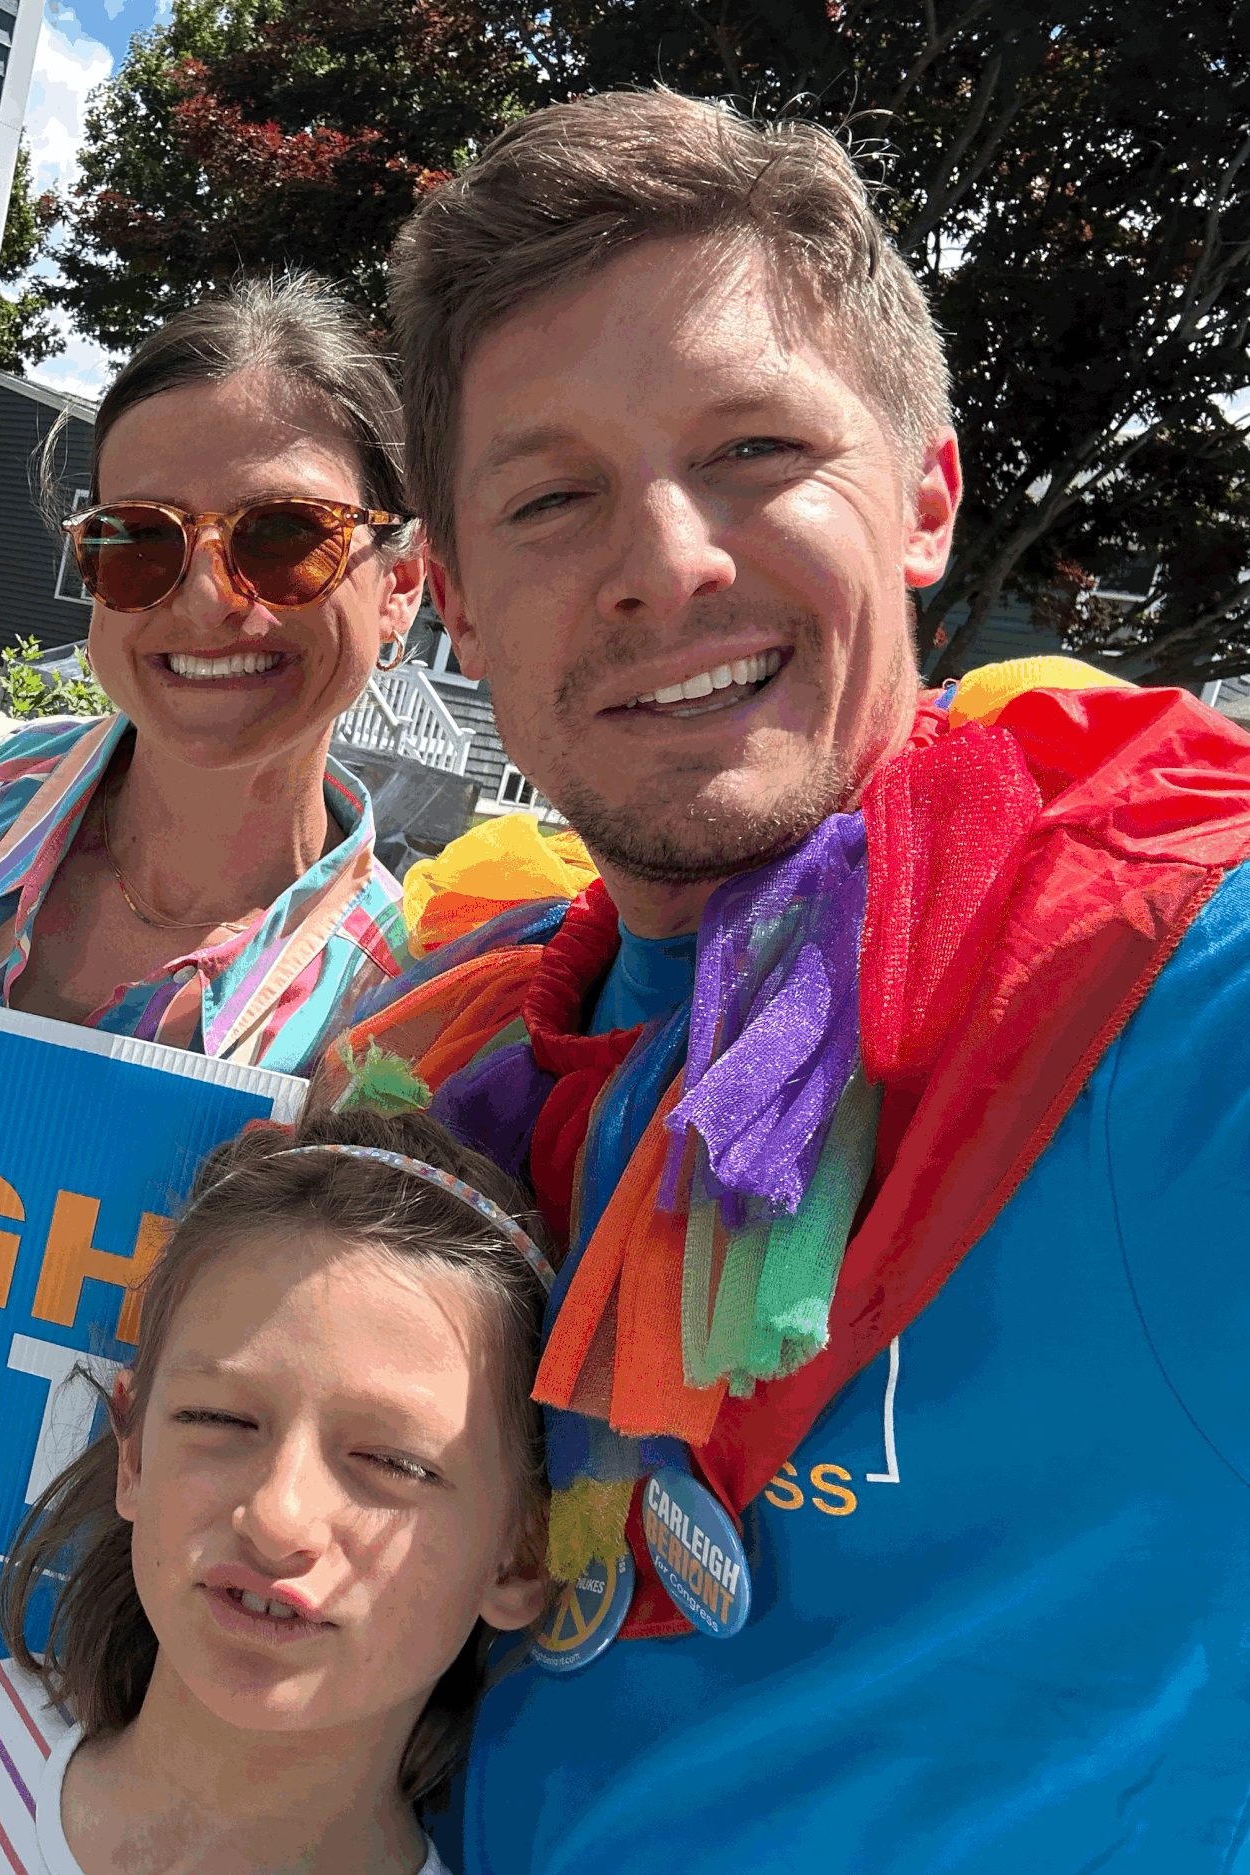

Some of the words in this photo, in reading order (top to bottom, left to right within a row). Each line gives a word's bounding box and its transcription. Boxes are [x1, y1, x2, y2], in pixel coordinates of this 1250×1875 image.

[645, 1507, 735, 1625] BERIONT
[648, 1478, 740, 1595] CARLEIGH
[654, 1554, 669, 1573] for
[669, 1573, 719, 1633] Congress
